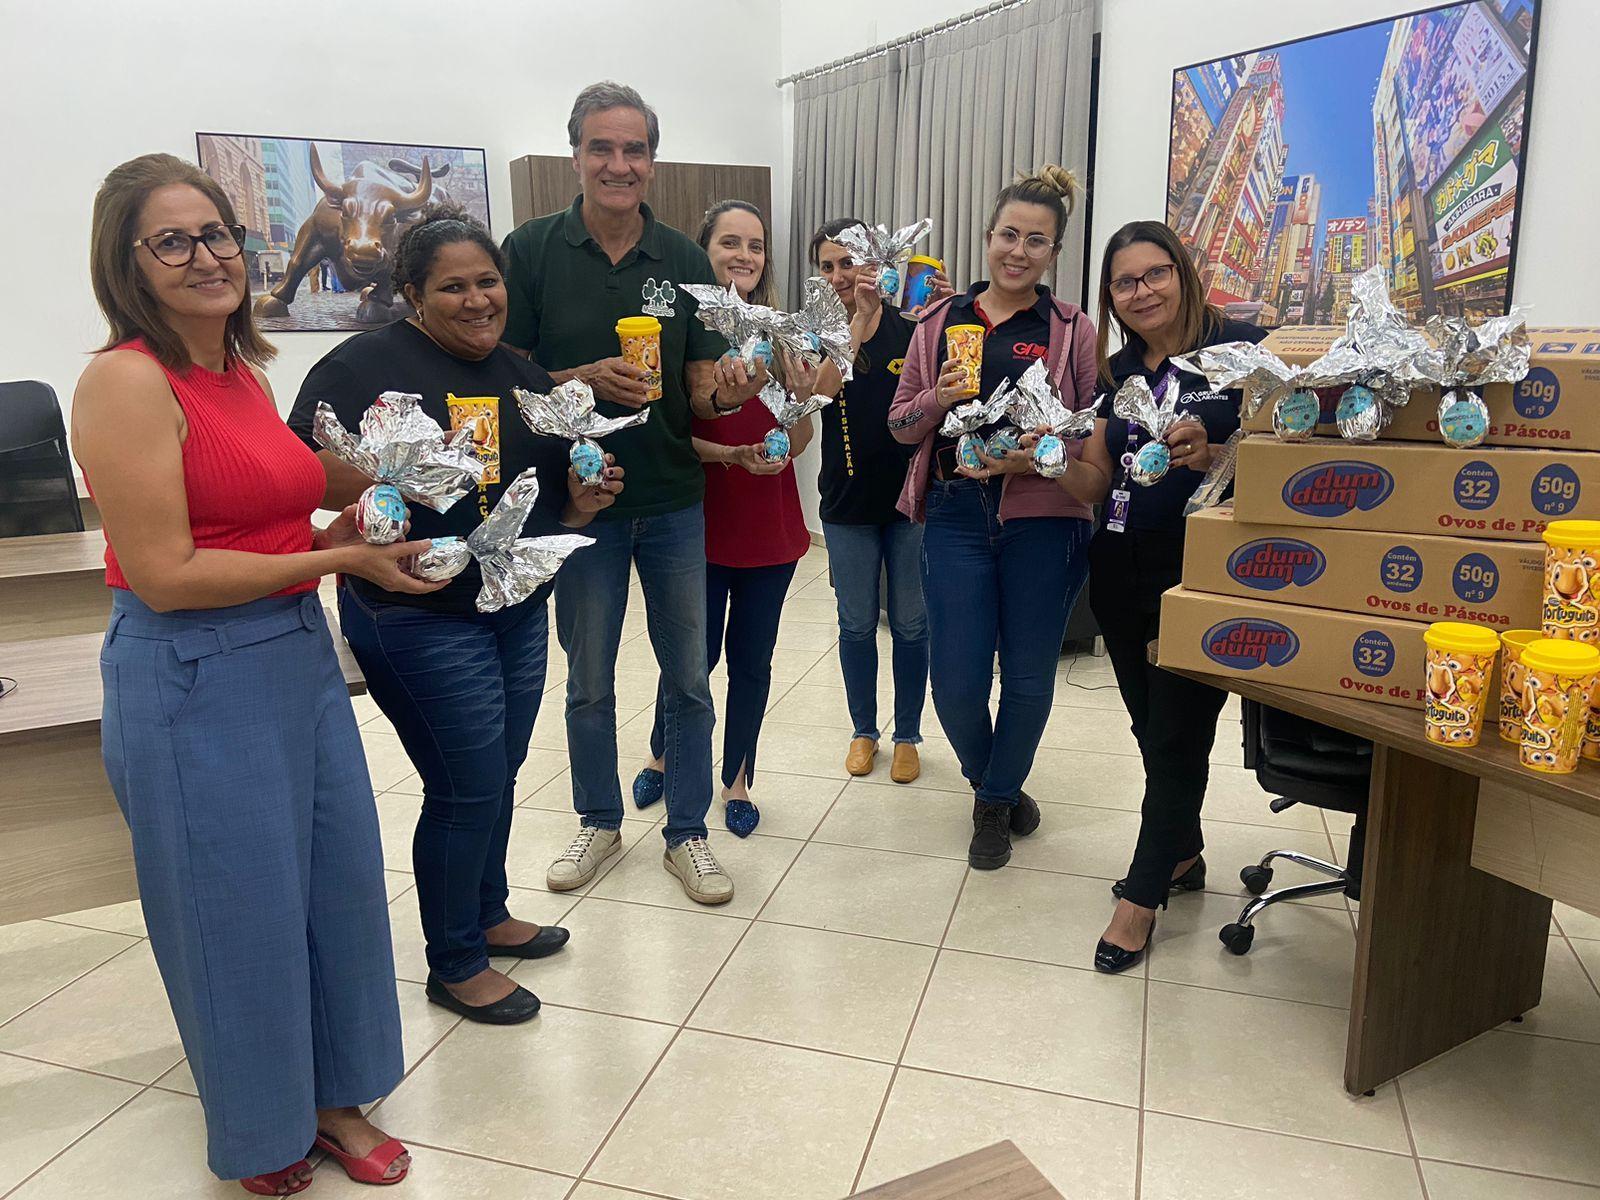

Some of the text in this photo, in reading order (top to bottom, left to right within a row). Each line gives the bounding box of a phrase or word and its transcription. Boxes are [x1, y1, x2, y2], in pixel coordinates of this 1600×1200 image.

[1327, 219, 1366, 232] オノテン
[1520, 380, 1556, 402] 50g
[1538, 405, 1545, 415] 9
[839, 382, 854, 477] INISTRAÇÃO
[1504, 423, 1572, 440] Páscoa
[1314, 467, 1380, 489] dum
[1461, 468, 1493, 477] Contém
[1292, 486, 1358, 510] dum
[1459, 479, 1491, 498] 32
[1538, 476, 1576, 499] 50g
[1557, 502, 1565, 512] 9
[1438, 514, 1486, 530] Ovos
[1491, 518, 1516, 531] de
[1254, 543, 1315, 565] dum
[1387, 552, 1417, 562] Contém
[1236, 559, 1294, 584] dum
[1385, 562, 1416, 583] 32
[1459, 564, 1495, 588] 50g
[1478, 591, 1485, 600] 9
[1366, 595, 1510, 625] Ovos de Páscoa
[1228, 622, 1287, 646] dum
[1359, 636, 1389, 647] Contém
[1211, 638, 1268, 663] dum
[1358, 646, 1387, 667] 32
[1340, 677, 1383, 695] Ovos
[1388, 686, 1410, 699] de
